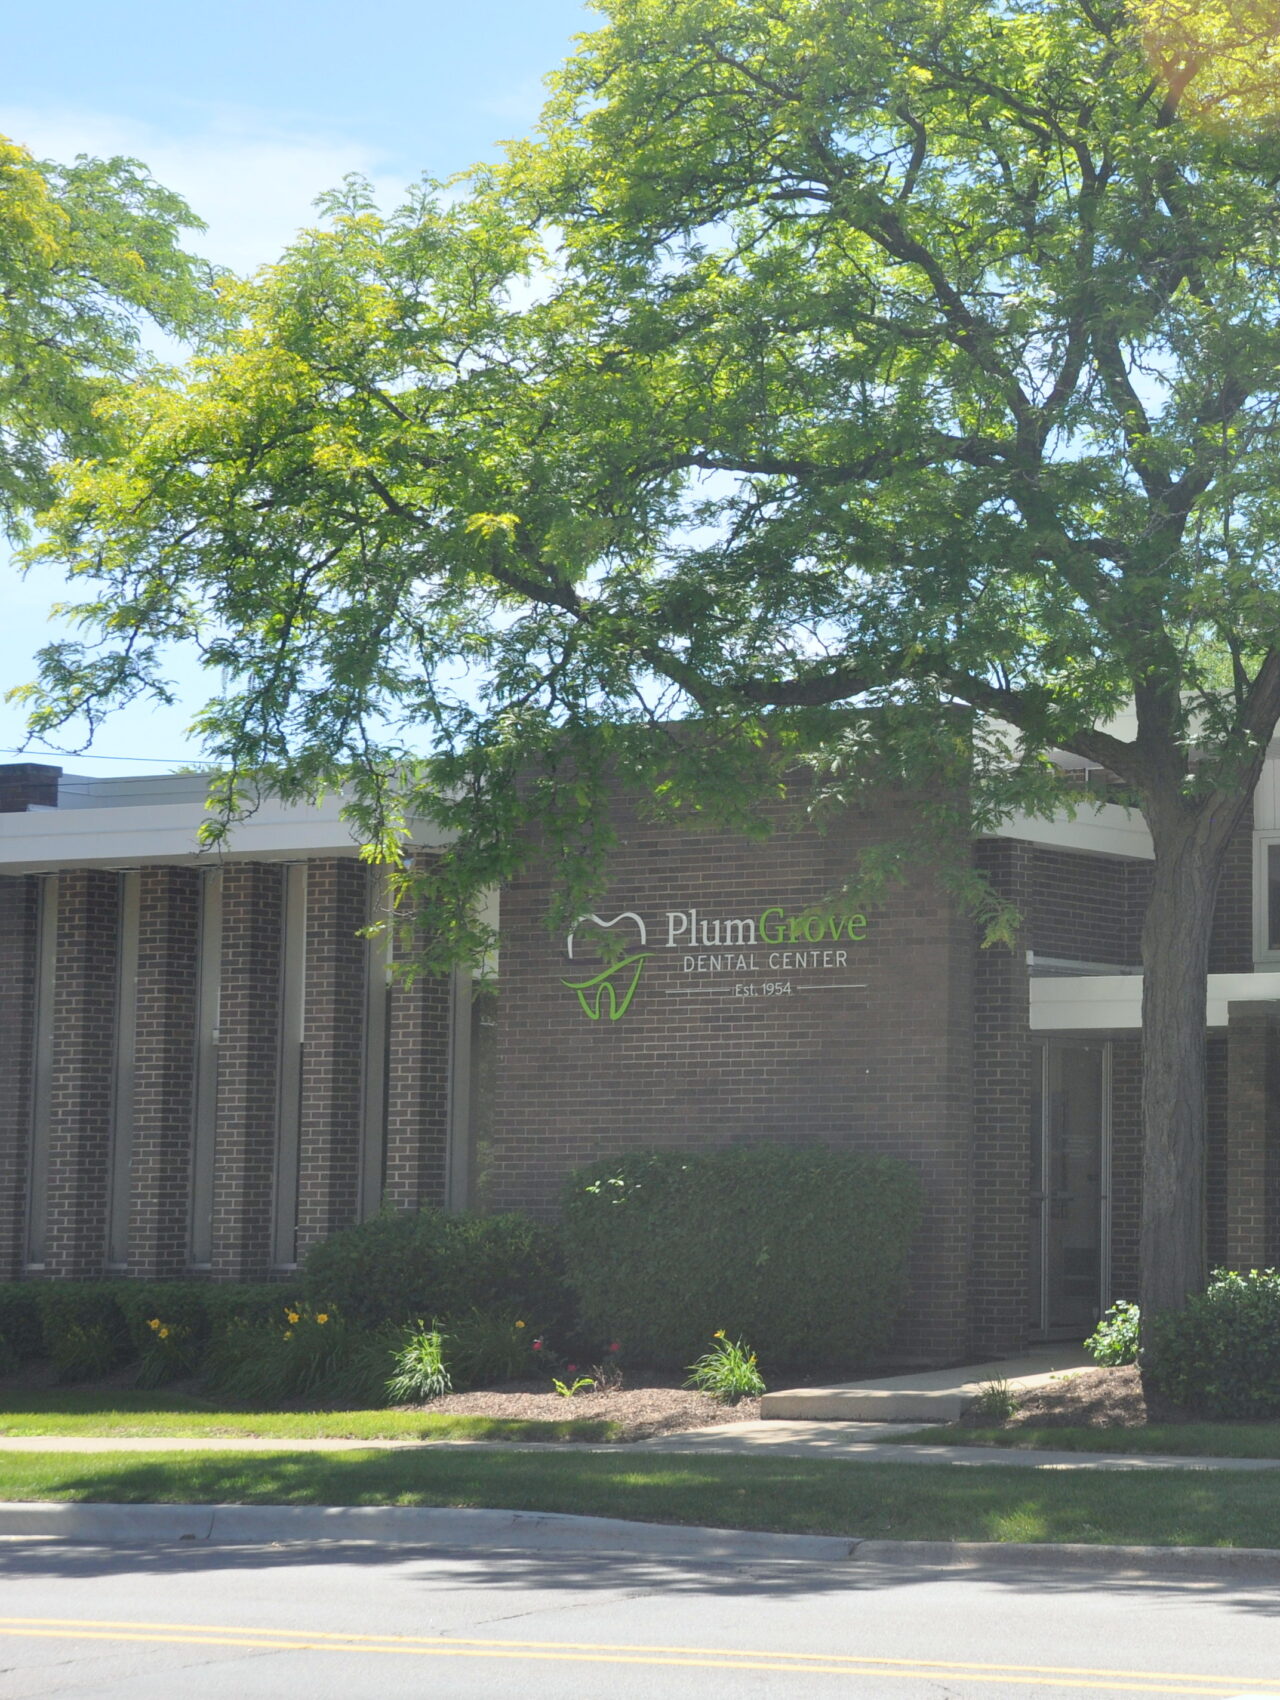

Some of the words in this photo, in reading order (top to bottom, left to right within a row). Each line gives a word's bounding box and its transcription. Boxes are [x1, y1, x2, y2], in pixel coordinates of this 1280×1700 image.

[665, 907, 868, 948] PlumGrove
[683, 954, 760, 973] DENTAL
[769, 950, 848, 970] CENTER
[735, 984, 758, 996] Est.
[762, 982, 792, 996] 1954
